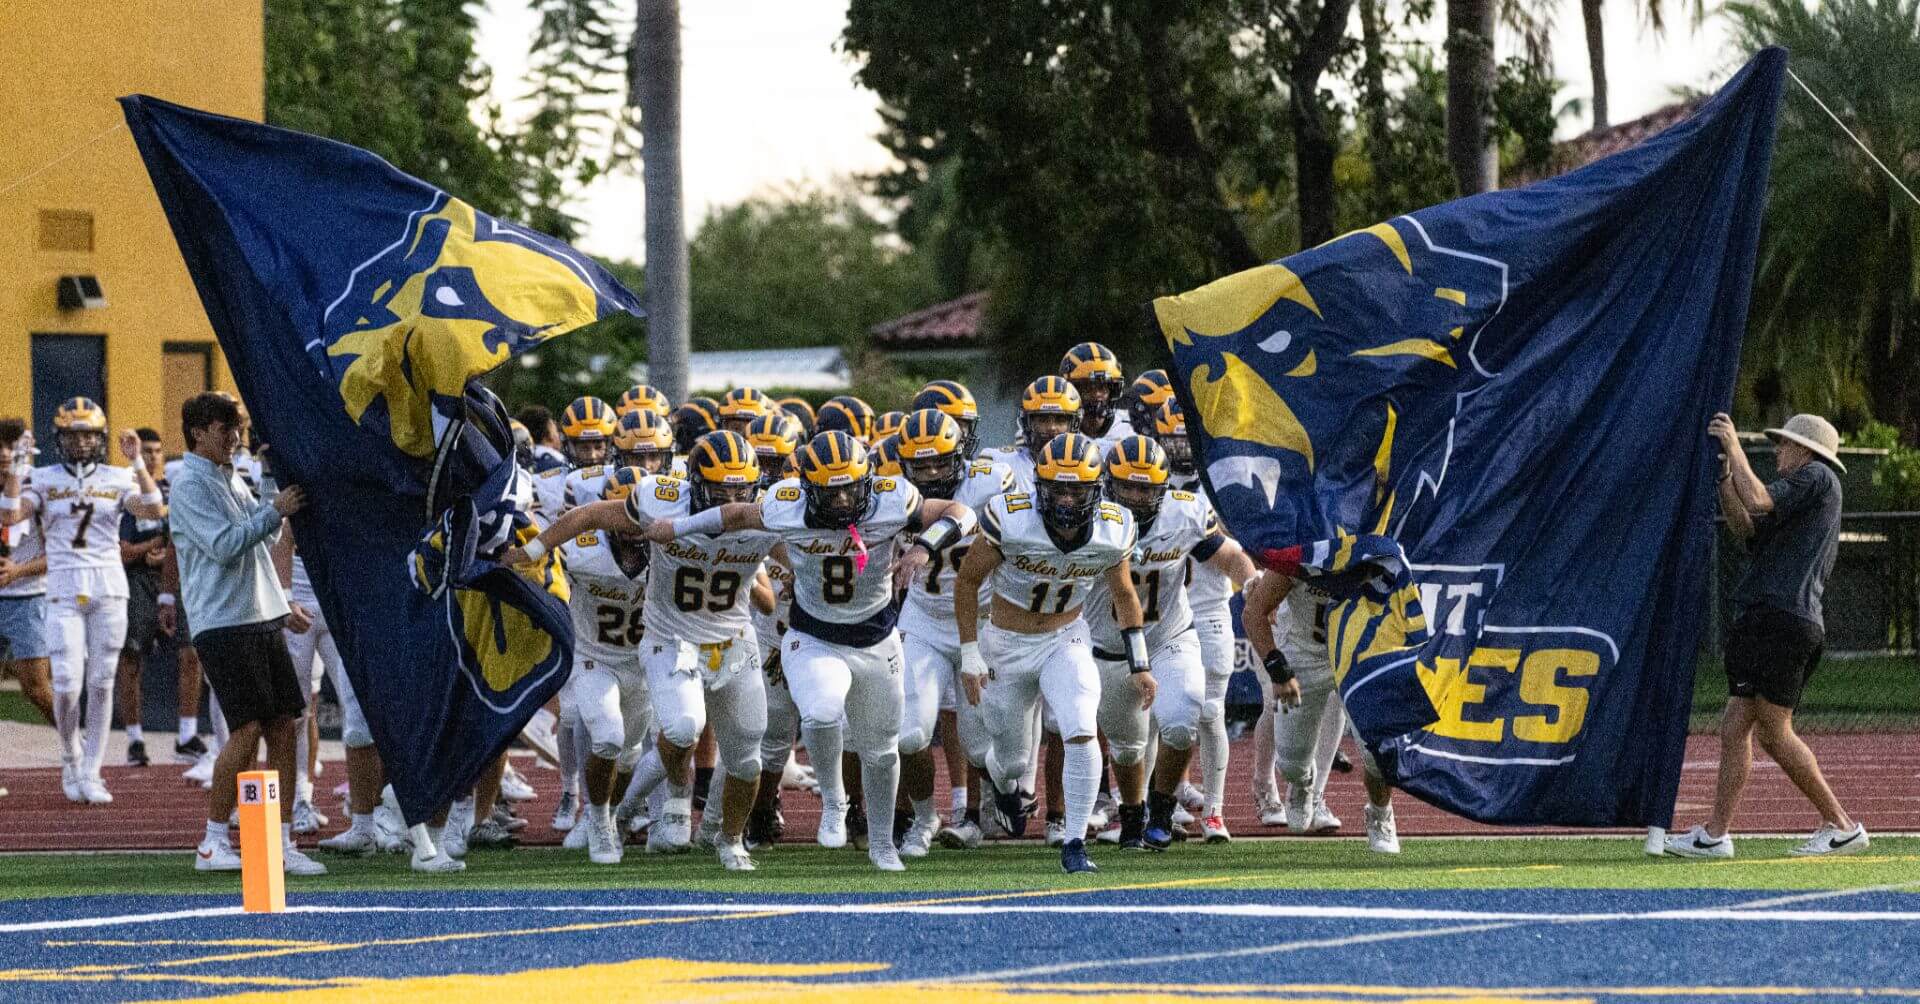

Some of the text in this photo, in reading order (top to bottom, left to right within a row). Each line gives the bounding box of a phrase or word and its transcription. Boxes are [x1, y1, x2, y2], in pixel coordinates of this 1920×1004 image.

[776, 487, 801, 502] 8
[70, 502, 94, 549] 7
[664, 542, 759, 566] Belen Jesuit
[1013, 554, 1058, 576] Belen
[1139, 547, 1181, 566] Jesuit
[674, 566, 741, 613] 69
[822, 556, 855, 604] 8
[1030, 582, 1074, 613] 11
